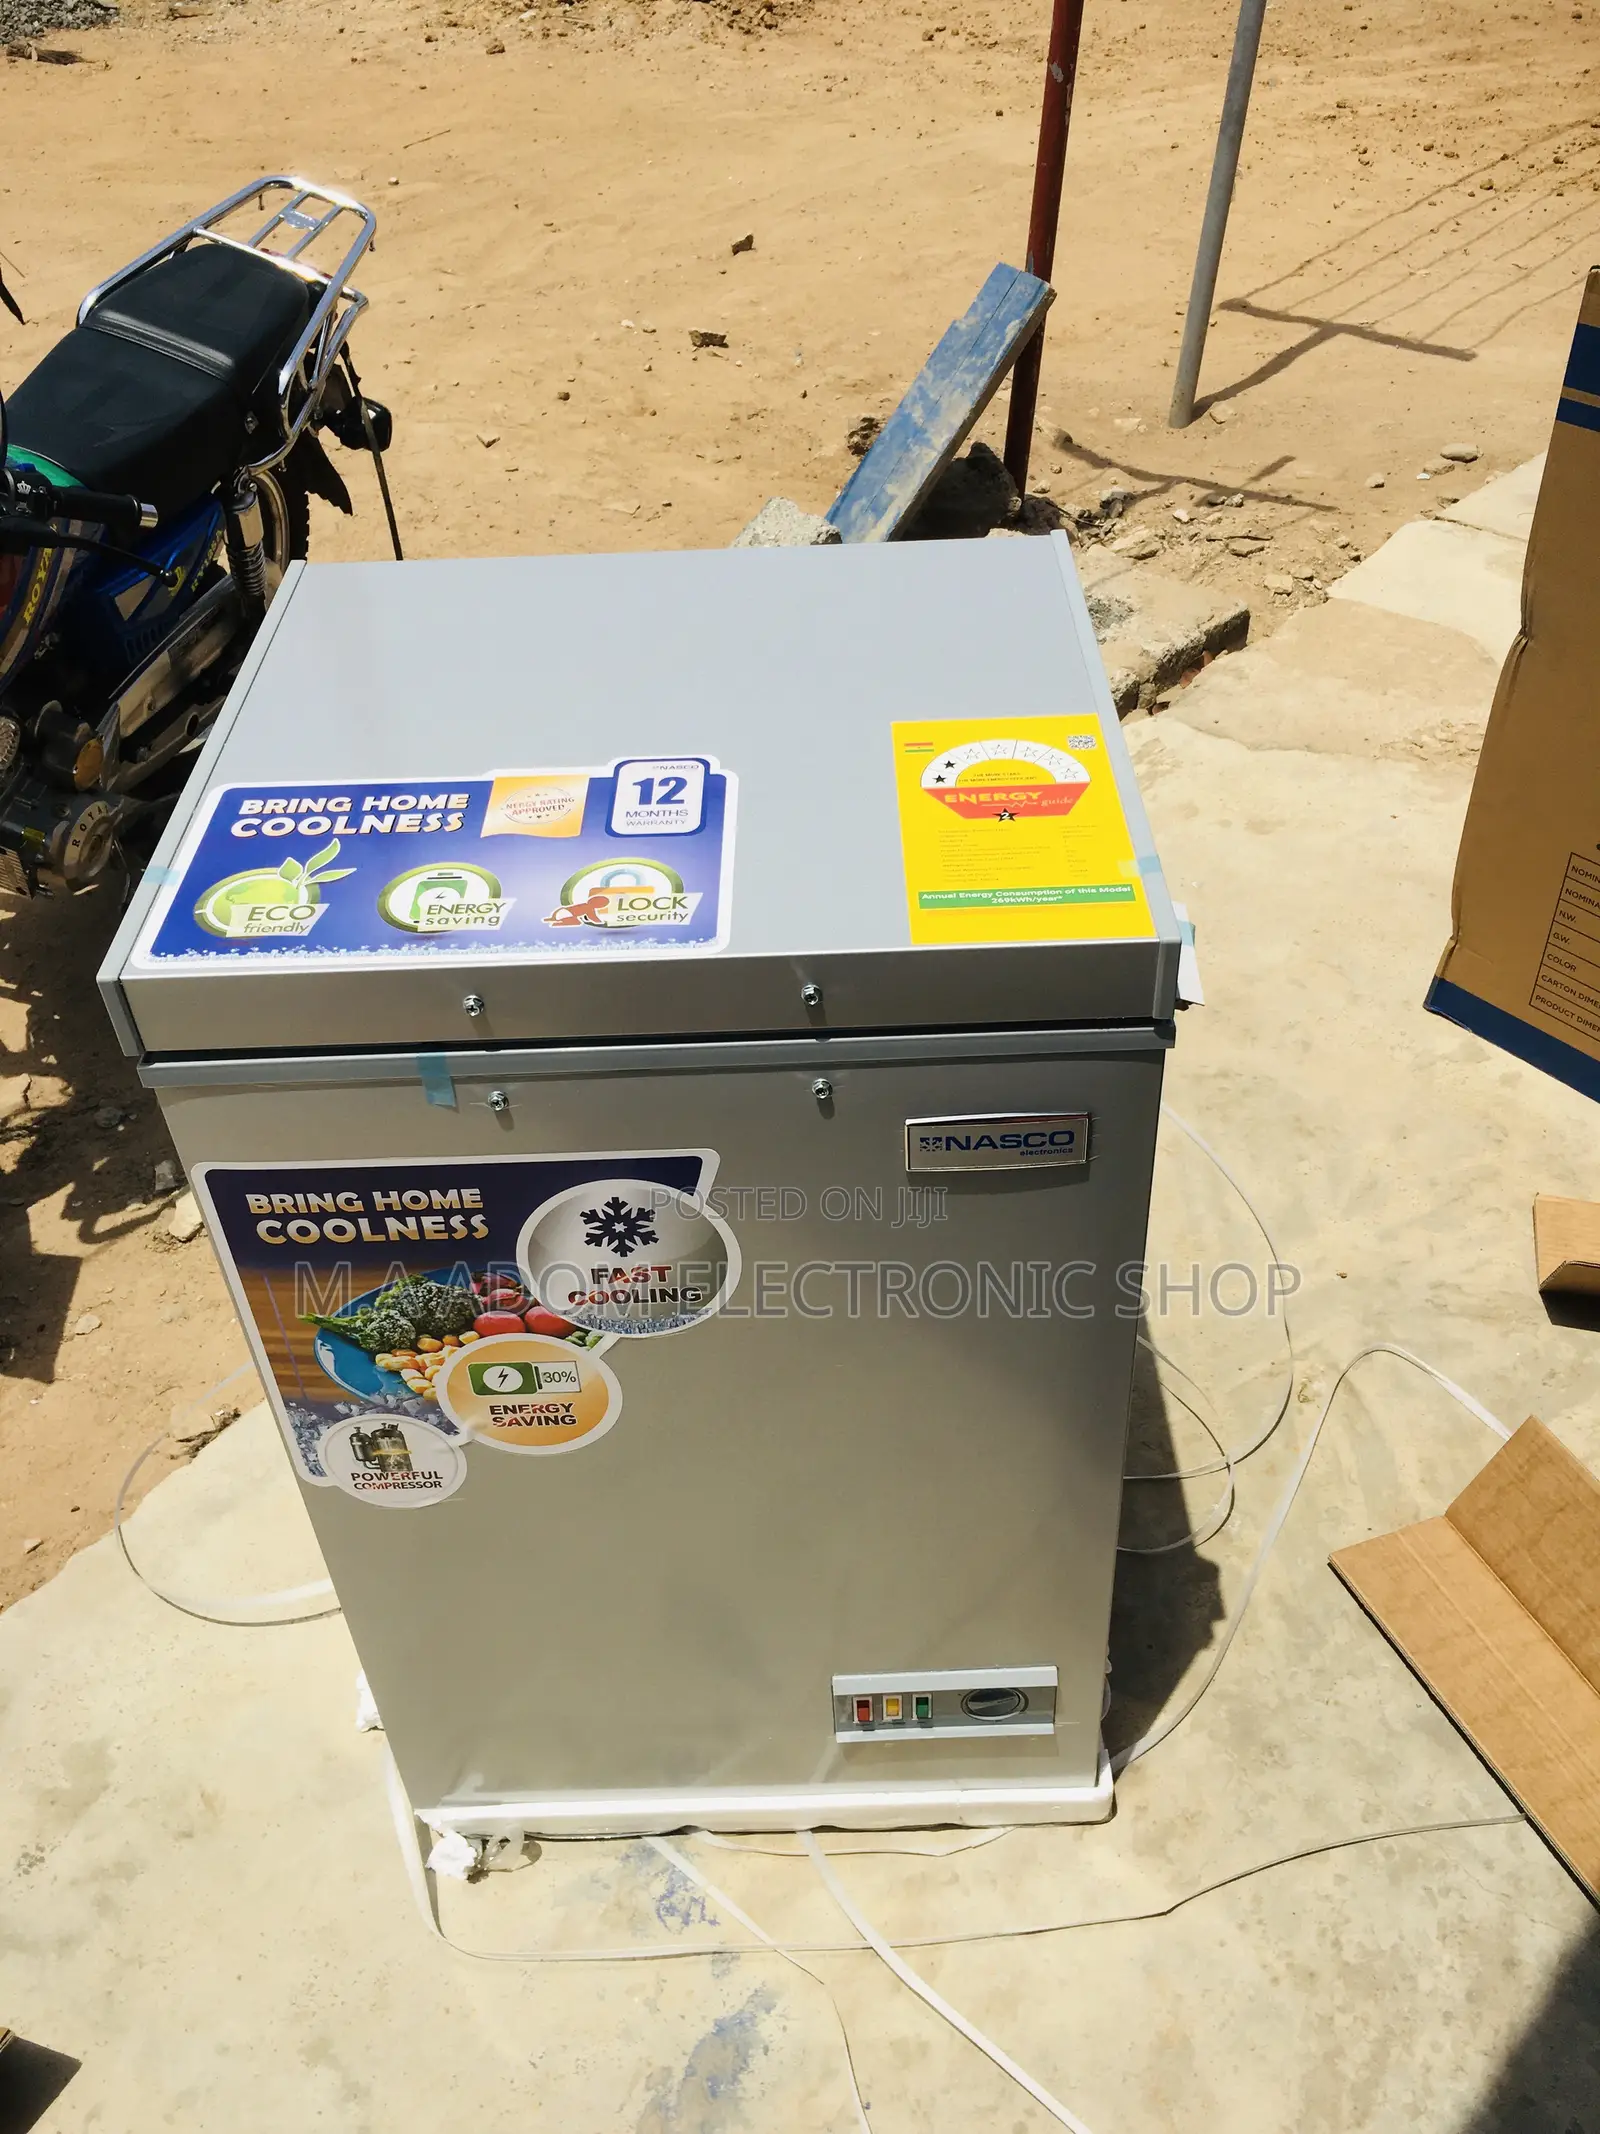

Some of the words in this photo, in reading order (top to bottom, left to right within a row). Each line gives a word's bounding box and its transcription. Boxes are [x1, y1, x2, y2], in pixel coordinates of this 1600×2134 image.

[632, 776, 688, 806] 12
[944, 791, 1043, 804] ENERGY
[238, 797, 353, 815] BRING
[362, 793, 470, 813] HOME
[625, 809, 689, 818] MONTHS
[230, 812, 466, 838] COOLNESS
[626, 819, 686, 827] WARRANTY
[922, 892, 957, 900] Annual
[959, 890, 993, 899] Energy
[996, 888, 1062, 898] Consumption
[1065, 888, 1075, 896] of
[1078, 886, 1097, 895] this
[1099, 885, 1131, 894] Model
[426, 902, 507, 916] ENERGY
[617, 896, 689, 912] LOCK
[249, 904, 316, 922] ECO
[616, 911, 689, 923] security
[243, 921, 310, 936] friendly
[425, 914, 501, 928] saving
[1546, 952, 1577, 973] COLOR
[1541, 973, 1577, 996] CARTON
[1535, 993, 1576, 1019] PRODUCT
[945, 1130, 1075, 1151] NASCO
[1019, 1147, 1073, 1157] electronics
[245, 1191, 364, 1215] BRING
[372, 1188, 484, 1212] HOME
[256, 1213, 490, 1245] COOLNESS
[590, 1265, 673, 1285] FAST
[567, 1286, 702, 1306] COOLING
[542, 1371, 577, 1383] 30%
[488, 1403, 574, 1415] ENERGY
[492, 1414, 577, 1427] SAVING
[350, 1471, 443, 1482] POWERFUL
[353, 1480, 443, 1490] COMPRESSOR
